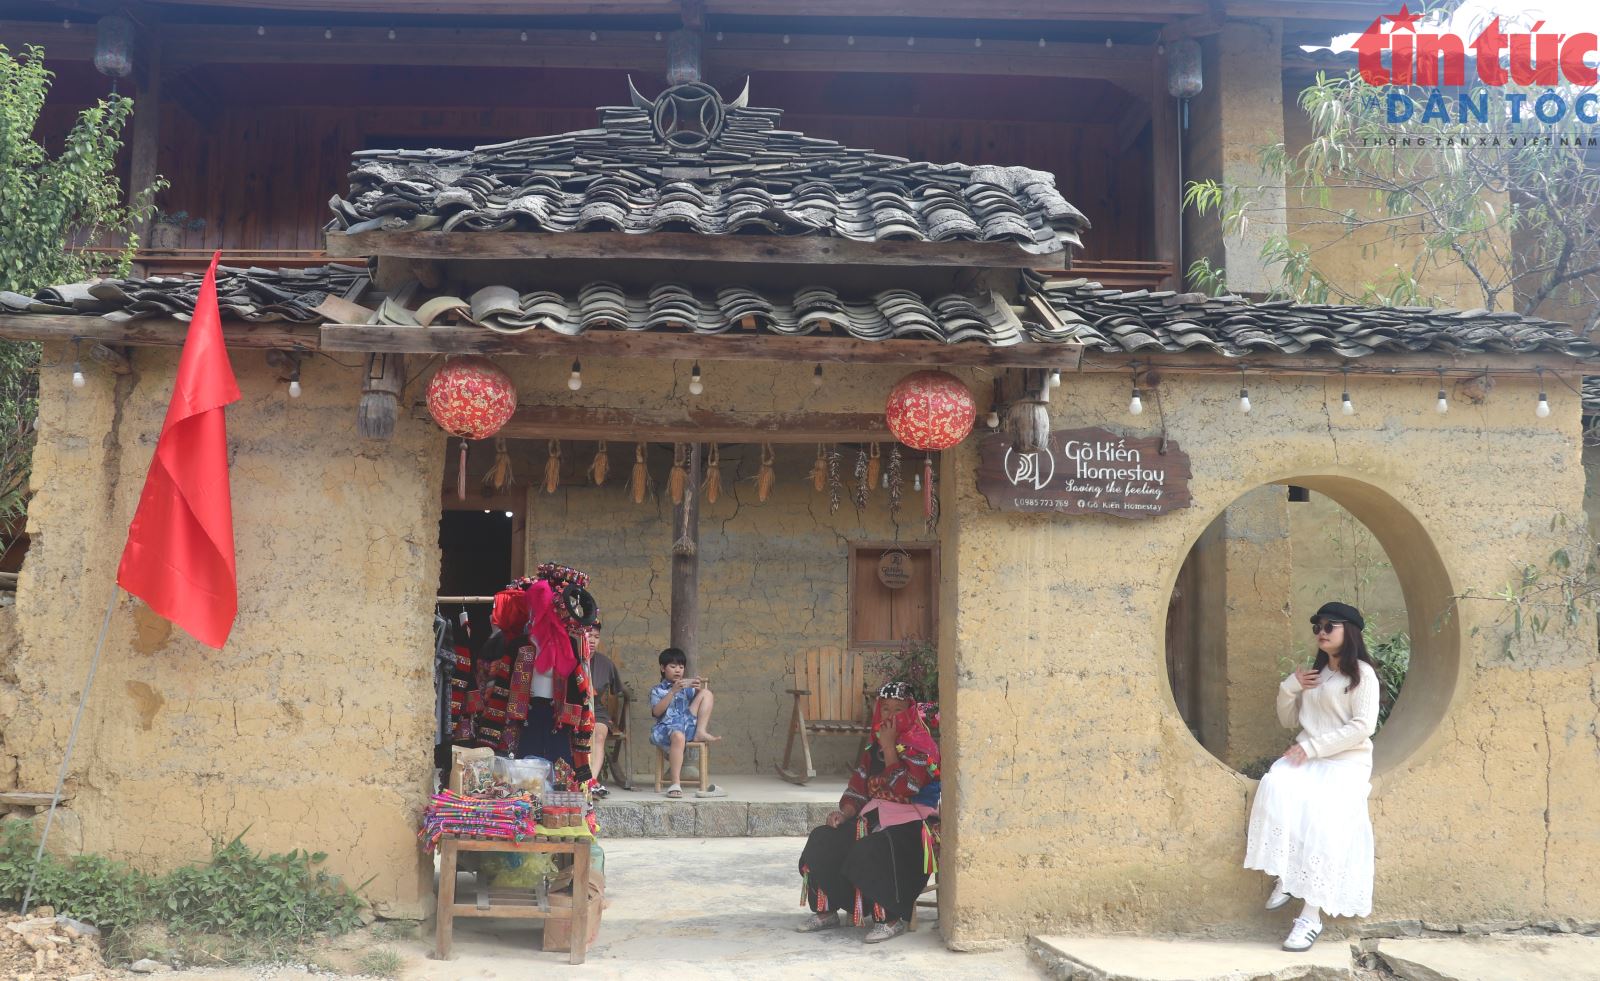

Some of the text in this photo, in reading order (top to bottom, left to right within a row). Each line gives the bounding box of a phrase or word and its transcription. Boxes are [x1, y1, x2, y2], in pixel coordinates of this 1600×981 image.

[1065, 439, 1140, 462] Gõ Kiến
[1077, 462, 1164, 485] Homestay
[1105, 481, 1121, 493] the
[1124, 482, 1163, 500] feeling
